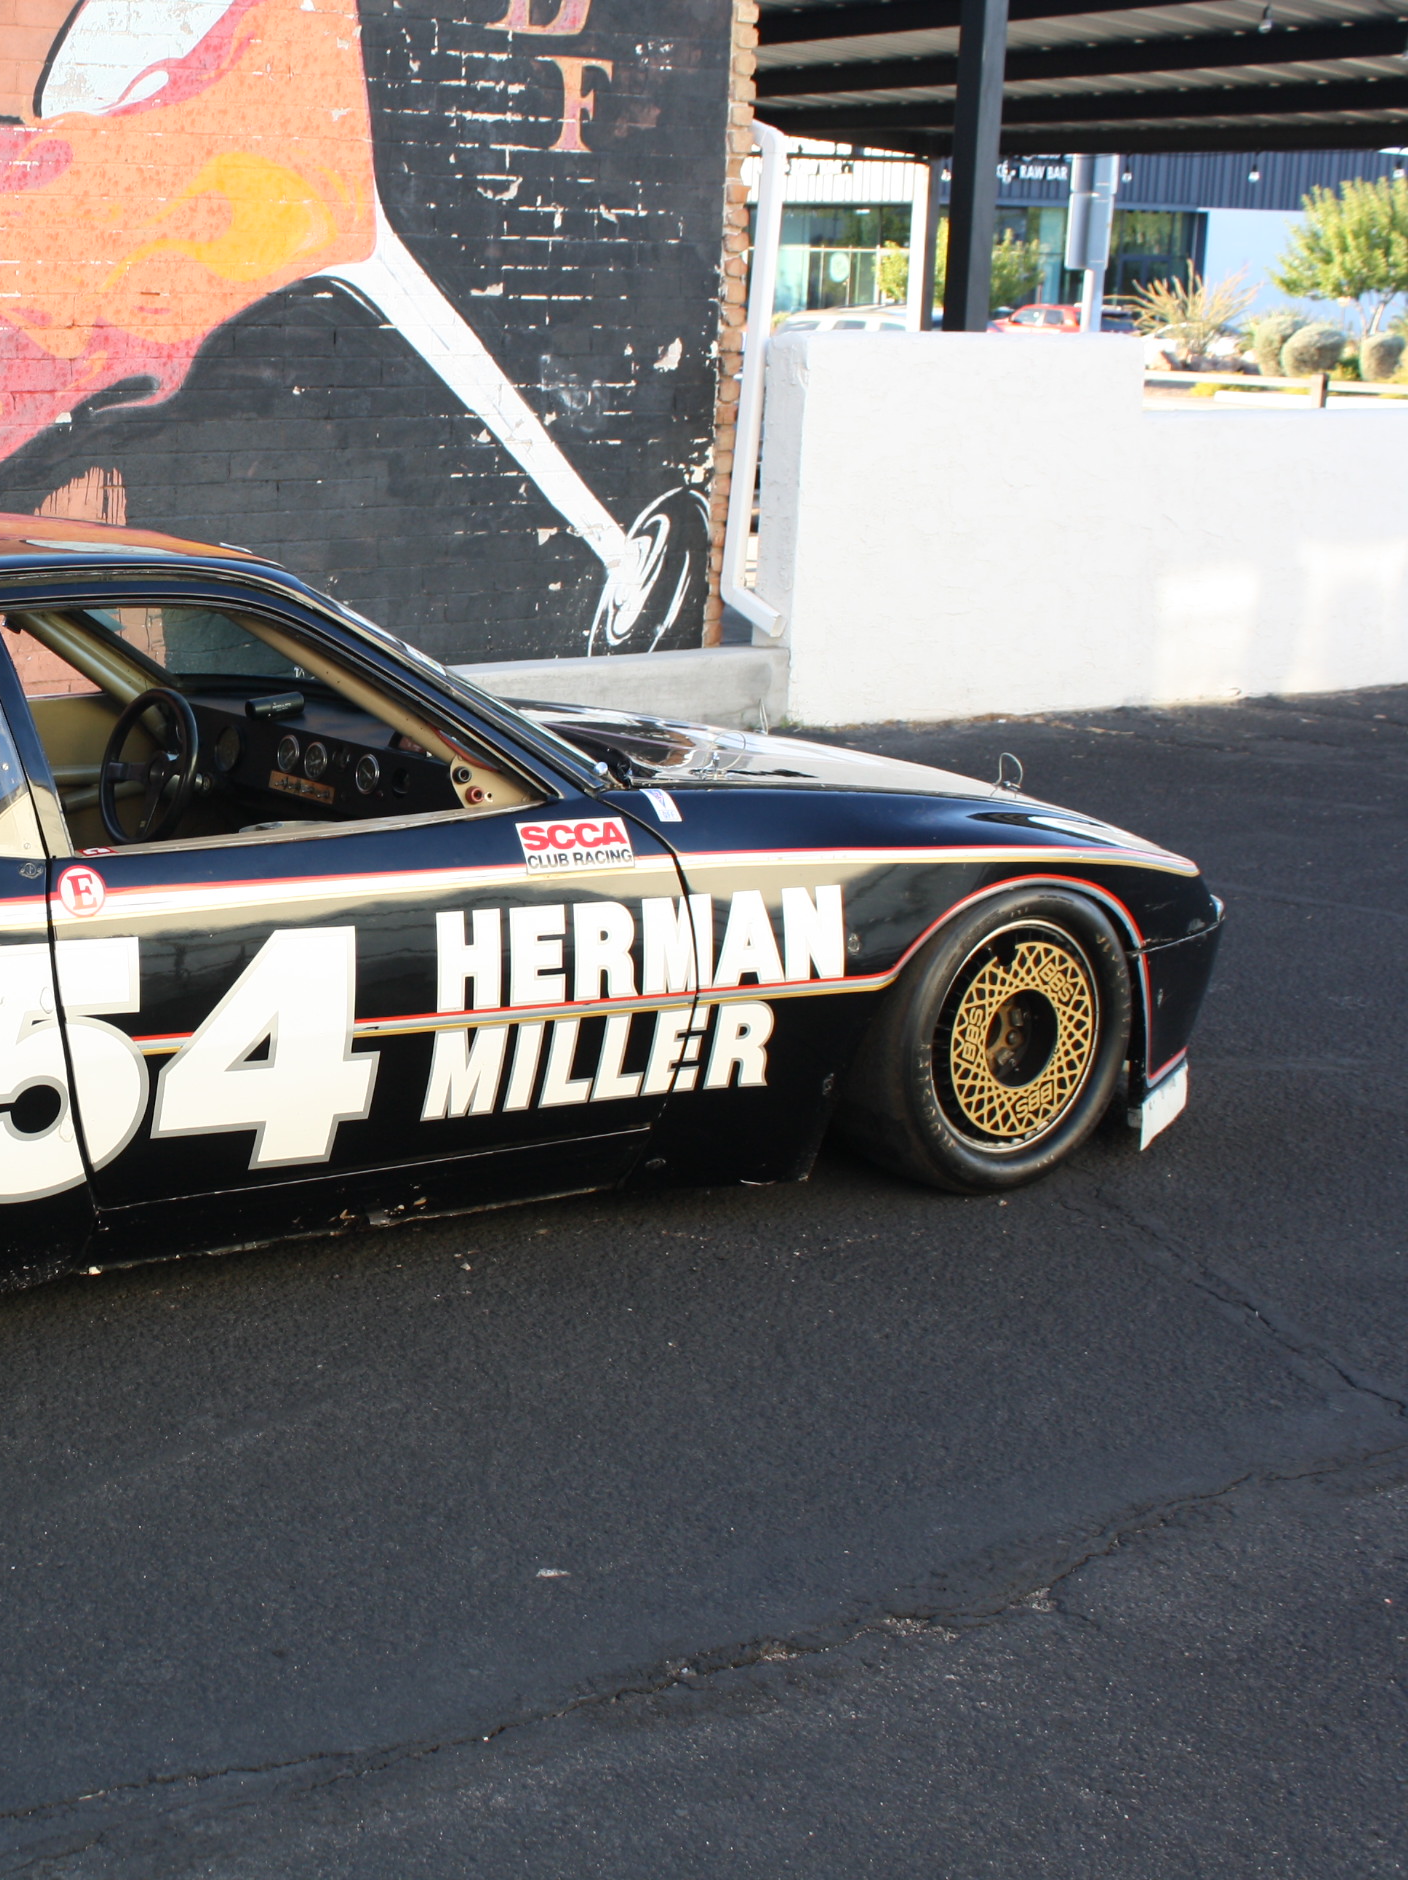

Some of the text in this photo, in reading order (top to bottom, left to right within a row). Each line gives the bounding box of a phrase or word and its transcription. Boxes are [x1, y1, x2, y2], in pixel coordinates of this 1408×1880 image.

[1019, 164, 1045, 180] RAW
[1046, 165, 1068, 180] BAR
[520, 821, 628, 851] SCCA
[527, 848, 633, 869] CLUB RACING
[66, 872, 97, 911] E
[435, 884, 846, 1015] HERMAN
[1039, 961, 1074, 1002] BBS
[962, 1007, 984, 1063] BBS
[420, 999, 775, 1122] MILLER
[1016, 1080, 1054, 1119] BBS
